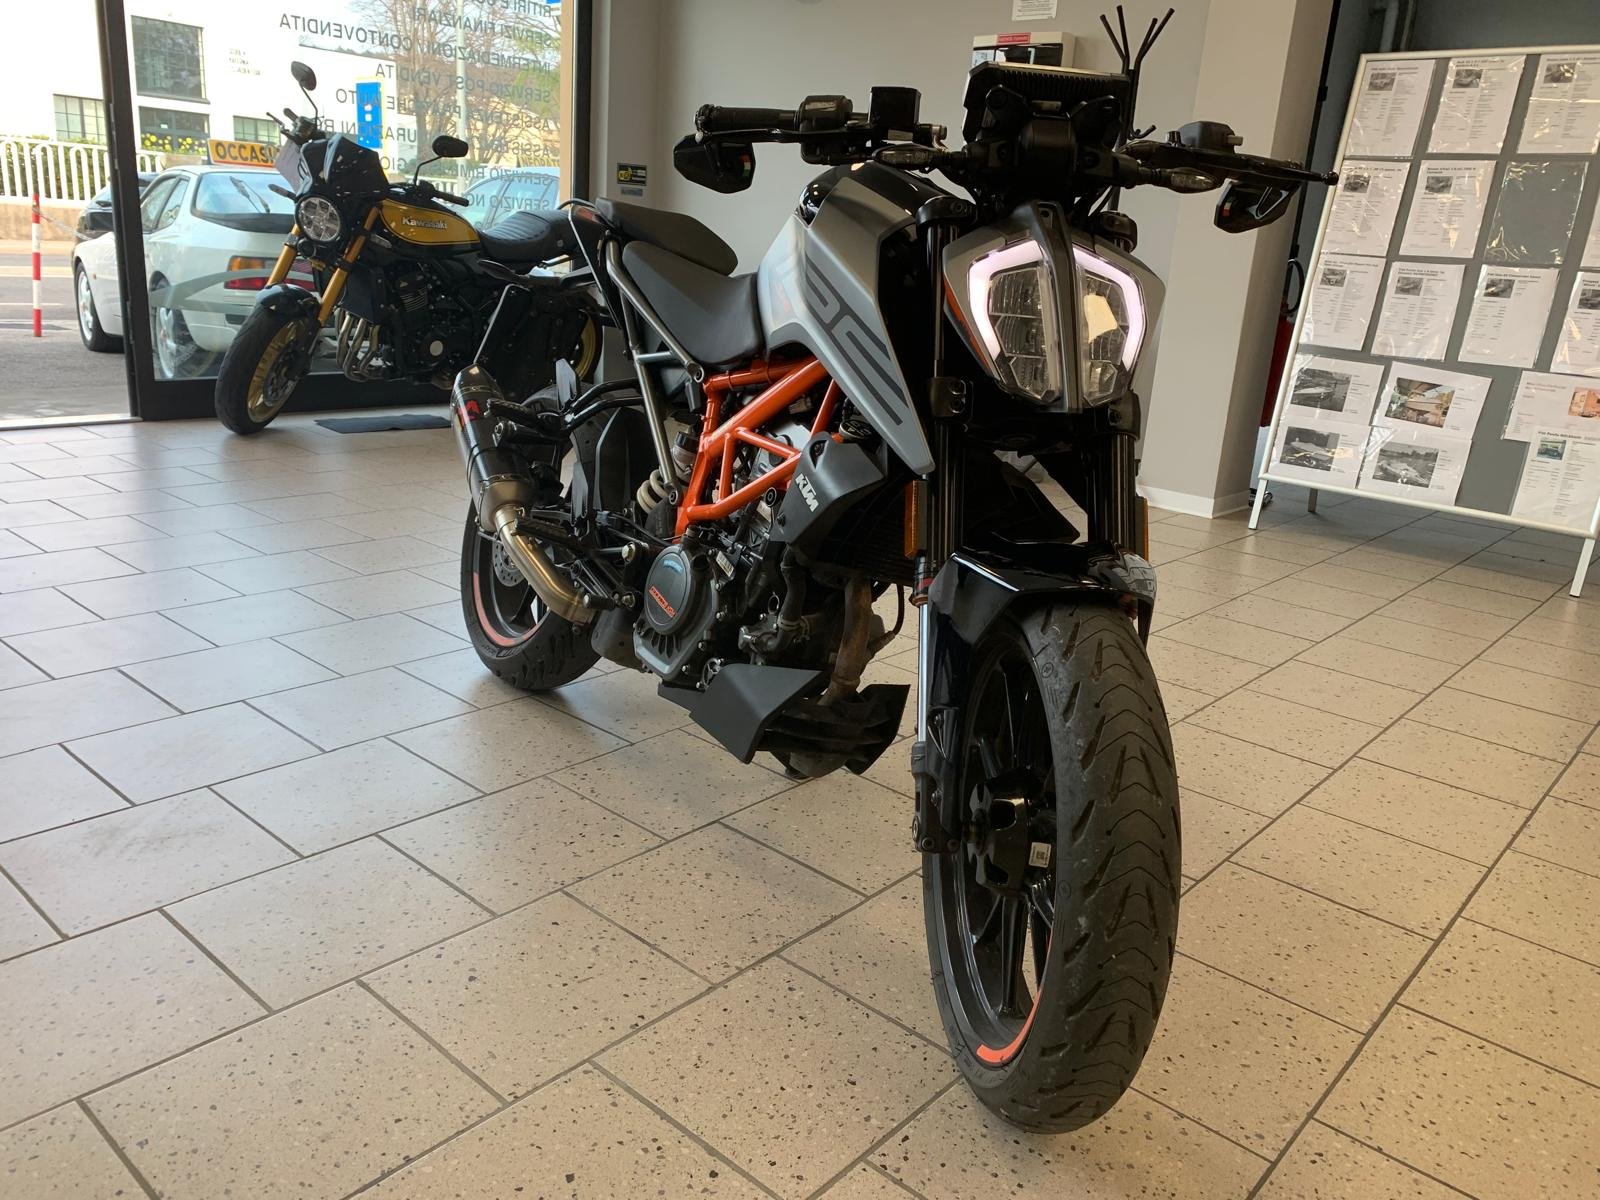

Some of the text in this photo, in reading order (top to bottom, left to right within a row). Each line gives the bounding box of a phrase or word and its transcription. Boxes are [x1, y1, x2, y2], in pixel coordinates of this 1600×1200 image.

[215, 142, 278, 164] OCCASI
[401, 216, 448, 230] Kawasaki
[795, 472, 819, 513] KTM
